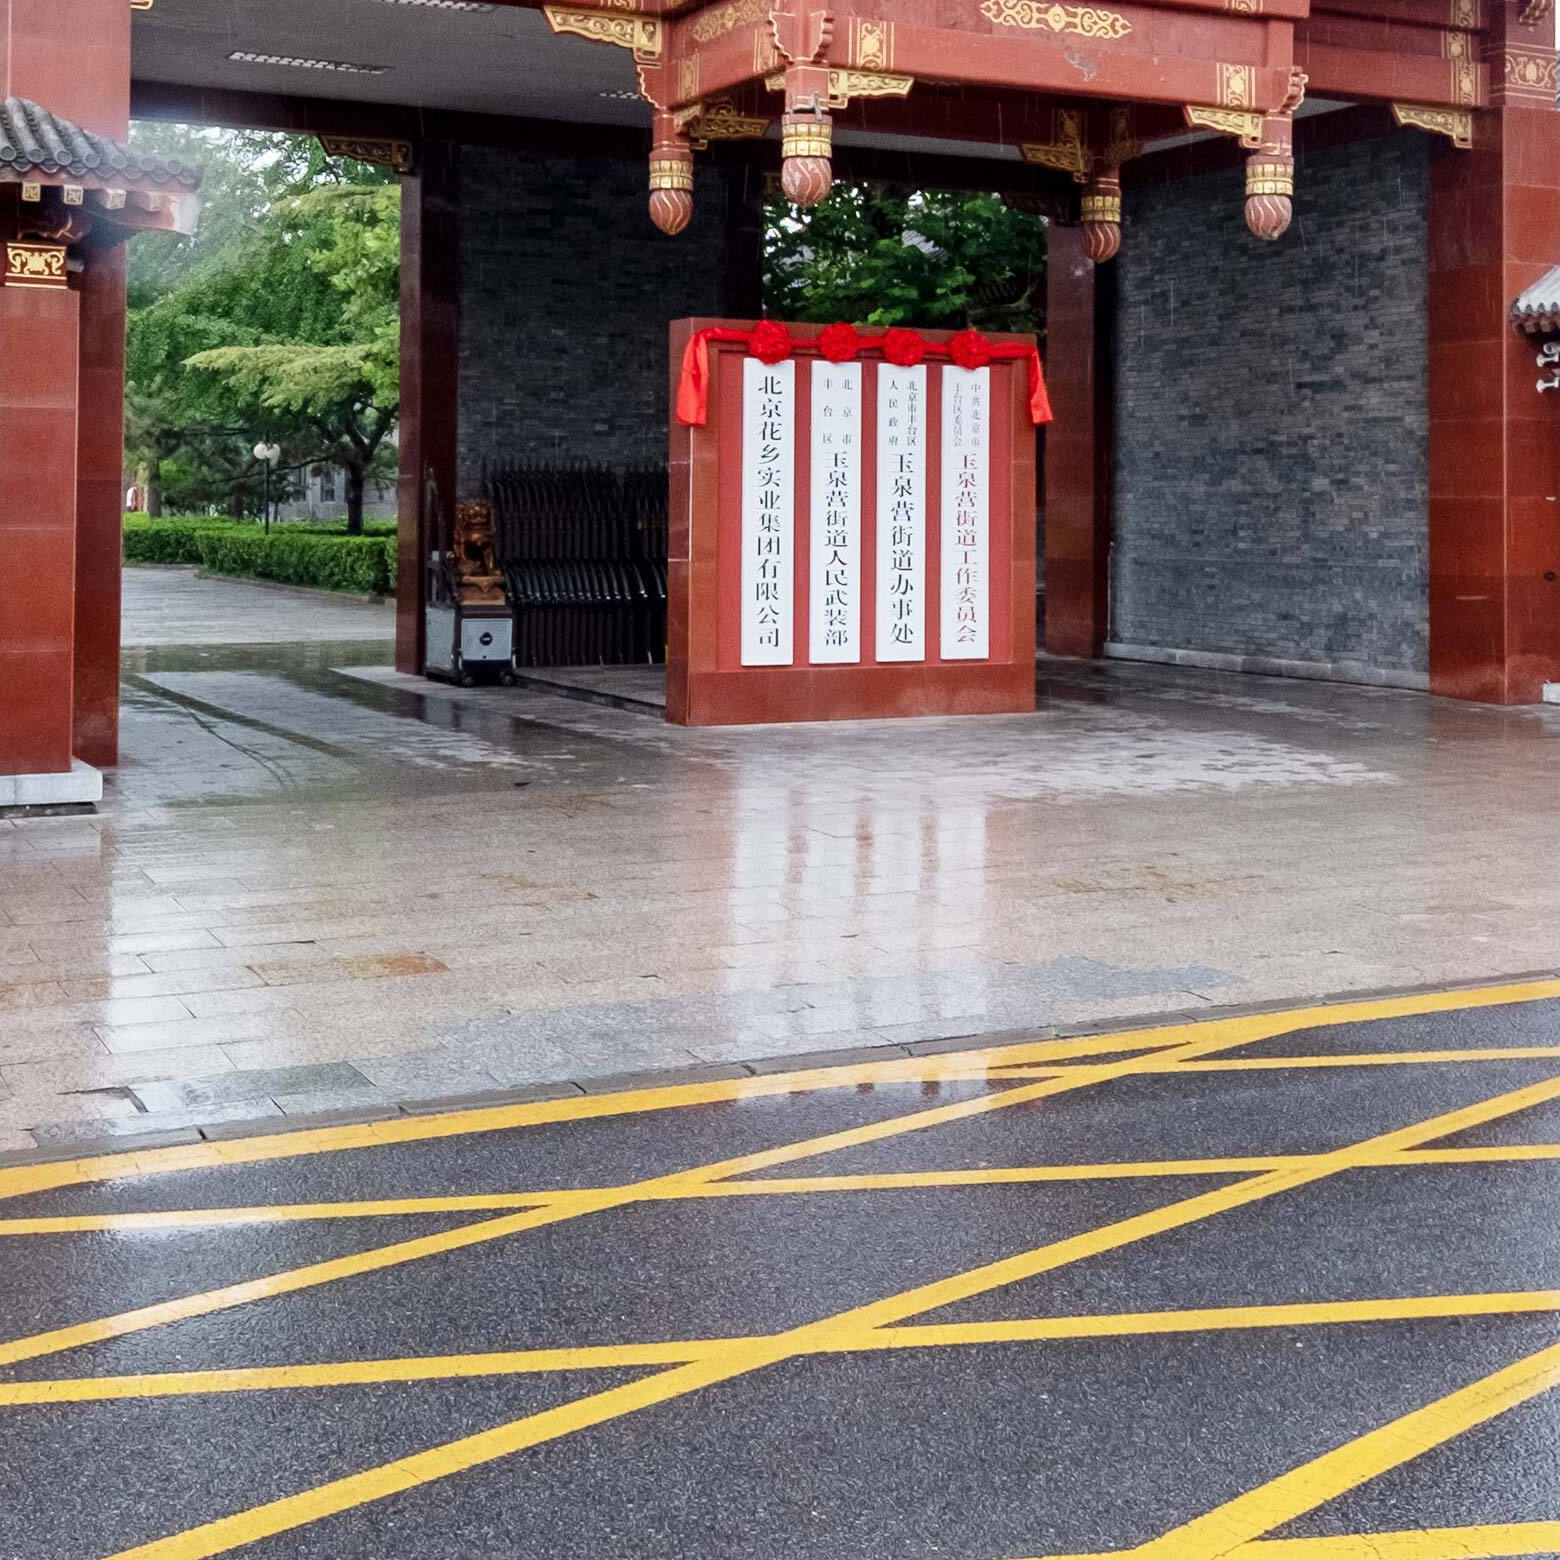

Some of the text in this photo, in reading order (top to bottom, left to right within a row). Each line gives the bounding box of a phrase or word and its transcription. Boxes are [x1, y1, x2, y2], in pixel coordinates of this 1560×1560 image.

[822, 378, 833, 445] 丰台区
[841, 379, 853, 445] 北京市
[906, 380, 918, 447] 北京市丰台区
[755, 375, 783, 648] 北京花乡实业集团有限公司
[824, 451, 849, 647] 玉泉营街道人民武装部
[890, 452, 915, 644] 玉泉营街道办事处
[955, 453, 978, 643] 玉泉营街道工作委员会
